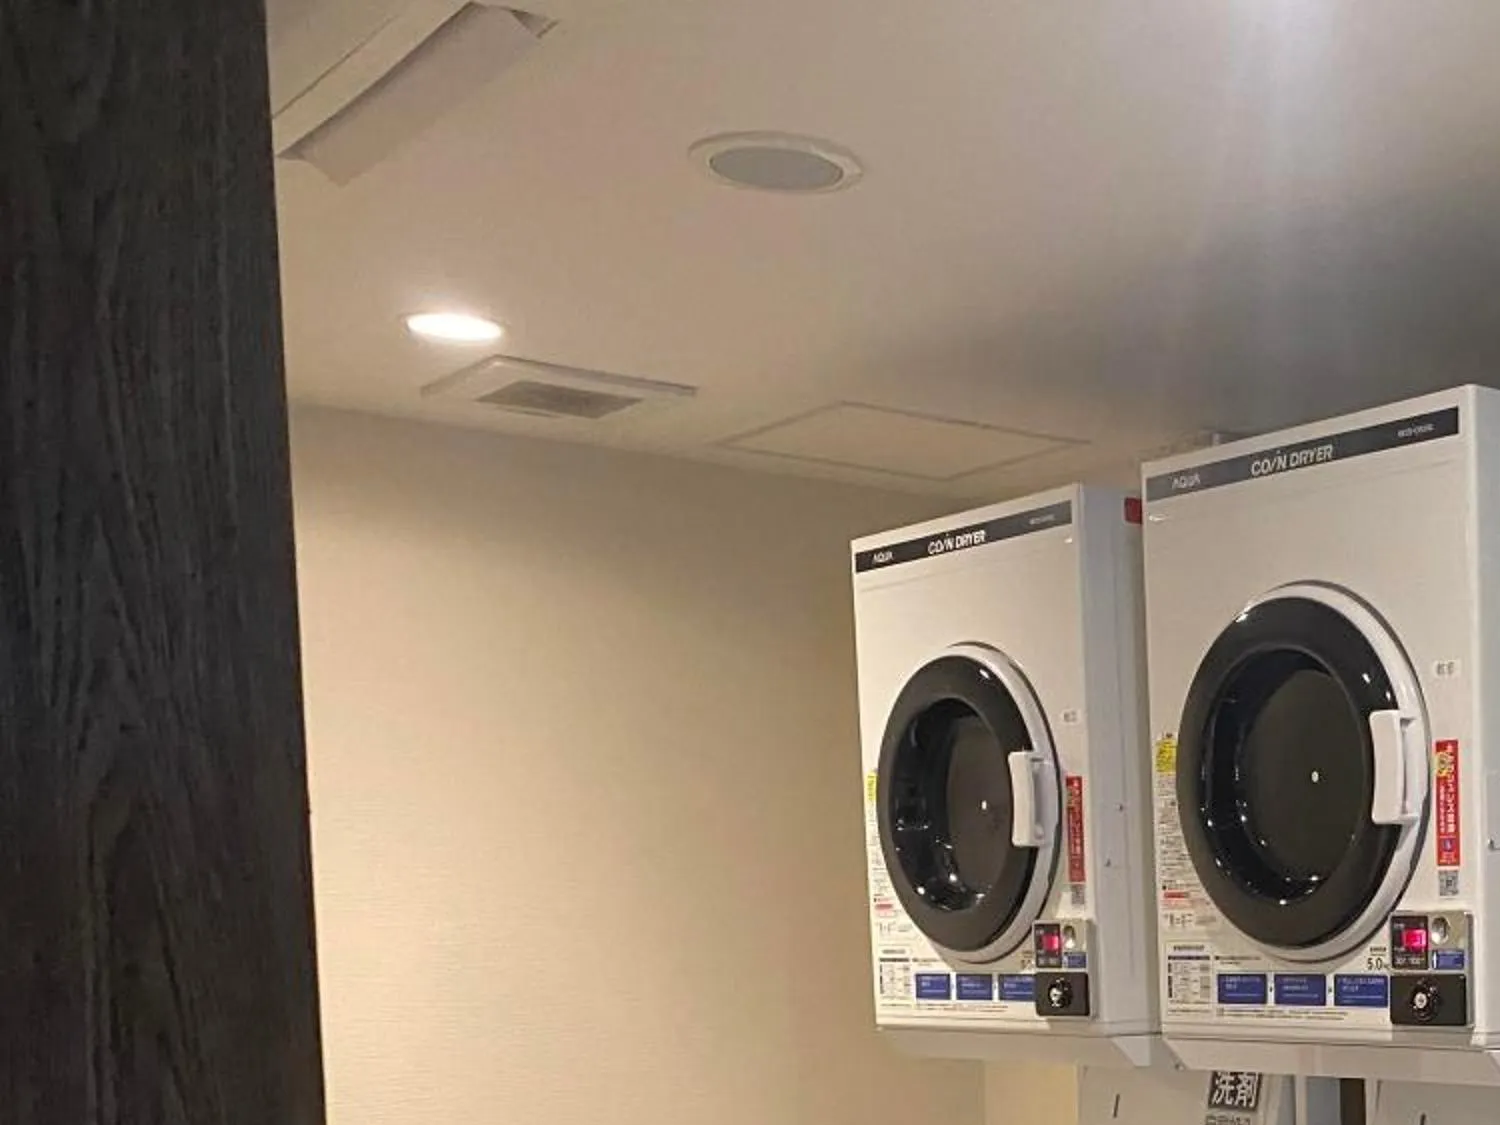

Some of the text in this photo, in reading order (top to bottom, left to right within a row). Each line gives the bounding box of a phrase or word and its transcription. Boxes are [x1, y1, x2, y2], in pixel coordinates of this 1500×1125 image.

[1289, 443, 1334, 469] DRYER
[1171, 473, 1201, 490] AQUA
[955, 529, 987, 550] DRYER
